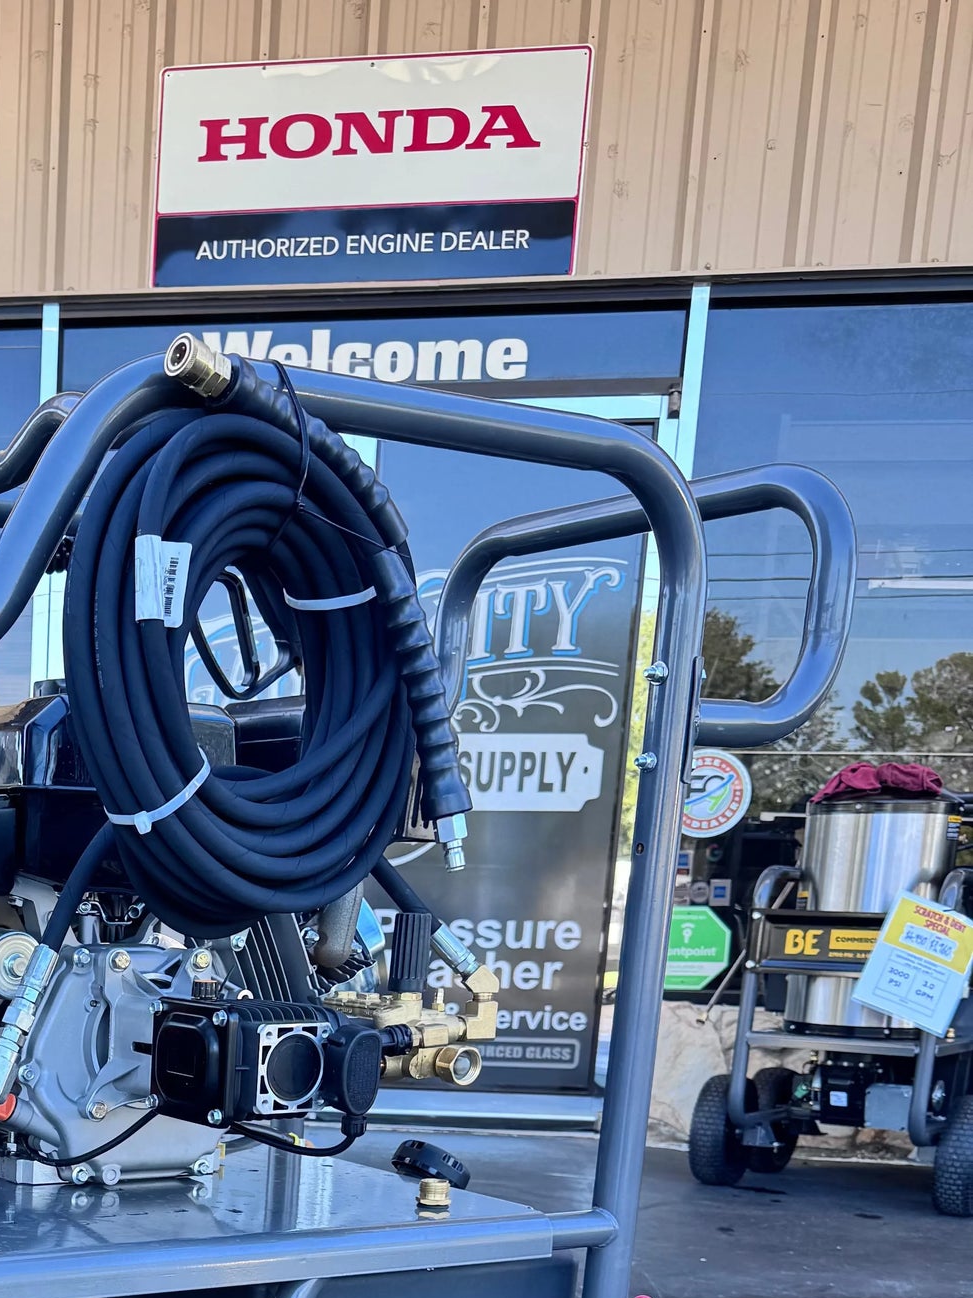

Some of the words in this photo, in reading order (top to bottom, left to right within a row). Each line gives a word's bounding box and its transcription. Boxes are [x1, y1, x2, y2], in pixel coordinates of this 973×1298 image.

[198, 105, 540, 162] HONDA
[196, 236, 339, 261] AUTHORIZED
[347, 233, 434, 254] ENGINE
[440, 229, 529, 252] DEALER
[201, 329, 528, 381] Welcome
[467, 566, 627, 662] ITY
[460, 751, 576, 793] SUPPLY
[374, 908, 581, 950] Pssure
[784, 929, 824, 955] BE
[924, 919, 950, 937] SPECIAL
[495, 1005, 588, 1031] ervice
[525, 1046, 572, 1060] GLASS
